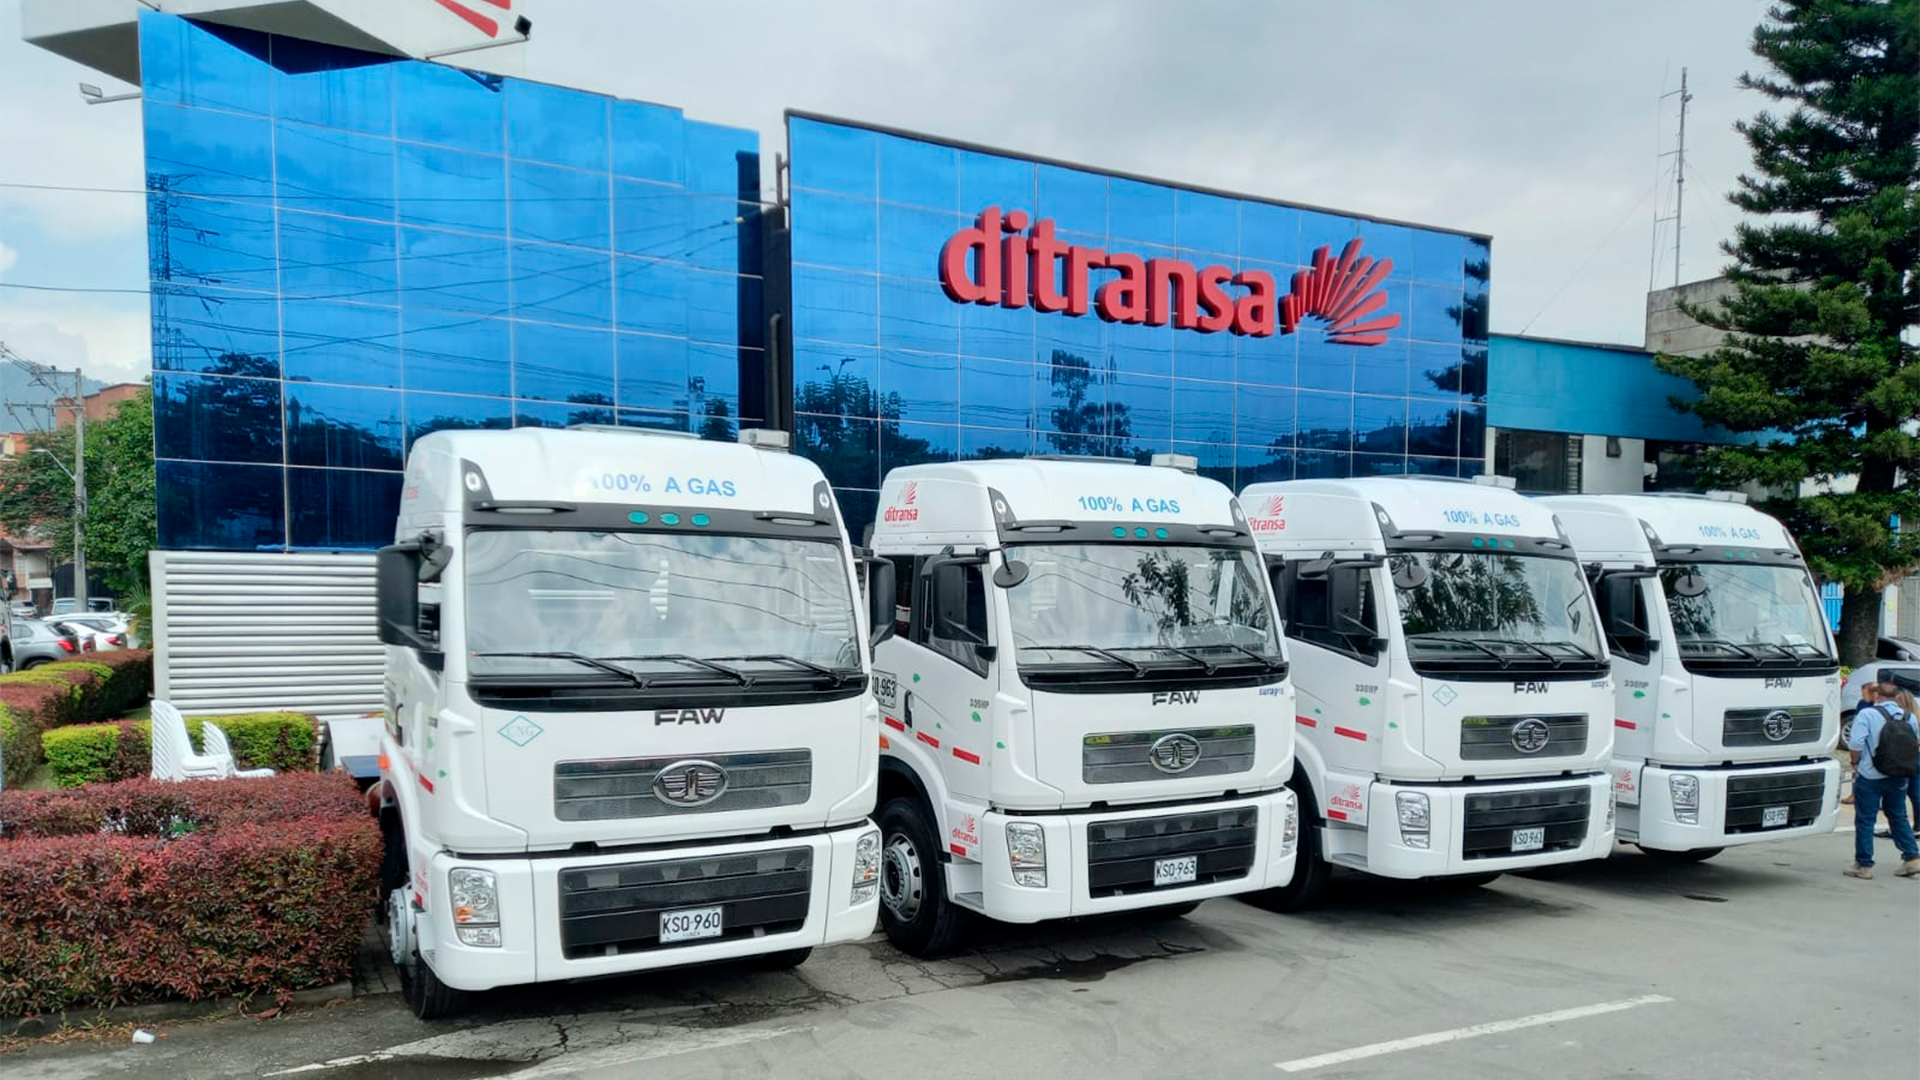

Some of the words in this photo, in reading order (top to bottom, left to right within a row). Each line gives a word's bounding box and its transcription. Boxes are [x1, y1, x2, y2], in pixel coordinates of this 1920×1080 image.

[938, 205, 1277, 338] ditransa
[665, 476, 682, 494] A
[687, 477, 737, 497] GAS
[1078, 496, 1123, 512] 100%
[1132, 497, 1144, 512] A
[1146, 498, 1181, 514] GAS
[884, 506, 918, 522] ditransa
[1443, 510, 1478, 525] 100%
[1484, 512, 1494, 525] A
[1495, 513, 1521, 527] GAS
[1248, 516, 1286, 531] itransa
[1699, 525, 1727, 538] 100%
[1731, 526, 1740, 539] A
[1740, 527, 1761, 540] GAS
[1513, 681, 1550, 694] FAW
[1765, 677, 1793, 689] FAW
[1152, 691, 1201, 706] FAW
[653, 708, 726, 727] FAW
[1330, 795, 1364, 811] ditransa
[951, 827, 979, 846] ditransa
